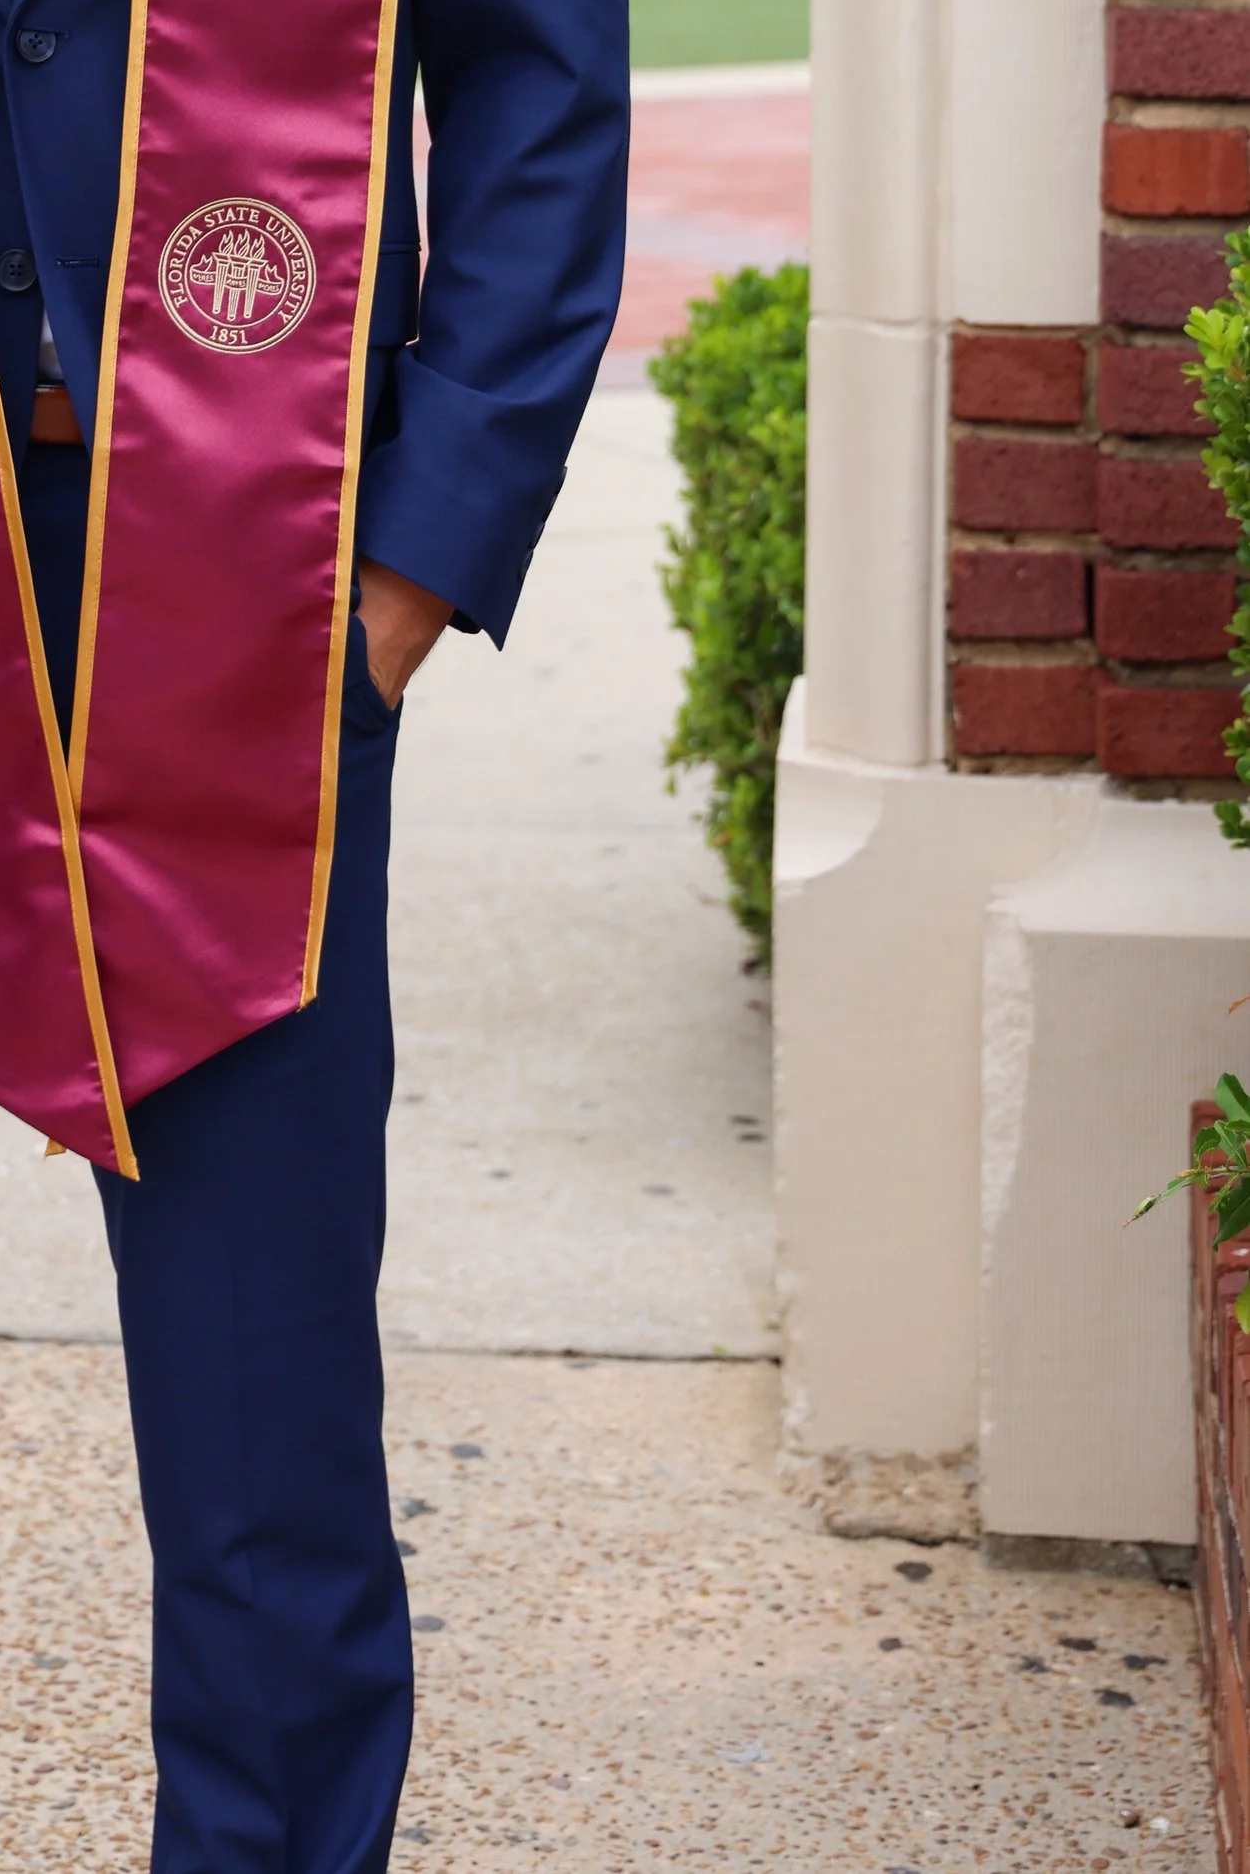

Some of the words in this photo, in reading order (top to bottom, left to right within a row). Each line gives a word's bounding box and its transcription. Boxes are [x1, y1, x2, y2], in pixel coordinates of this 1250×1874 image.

[169, 227, 202, 306] FLORIDA
[204, 208, 259, 227] STATE
[266, 218, 306, 324] UNIVERSITY
[210, 326, 248, 344] 1851
